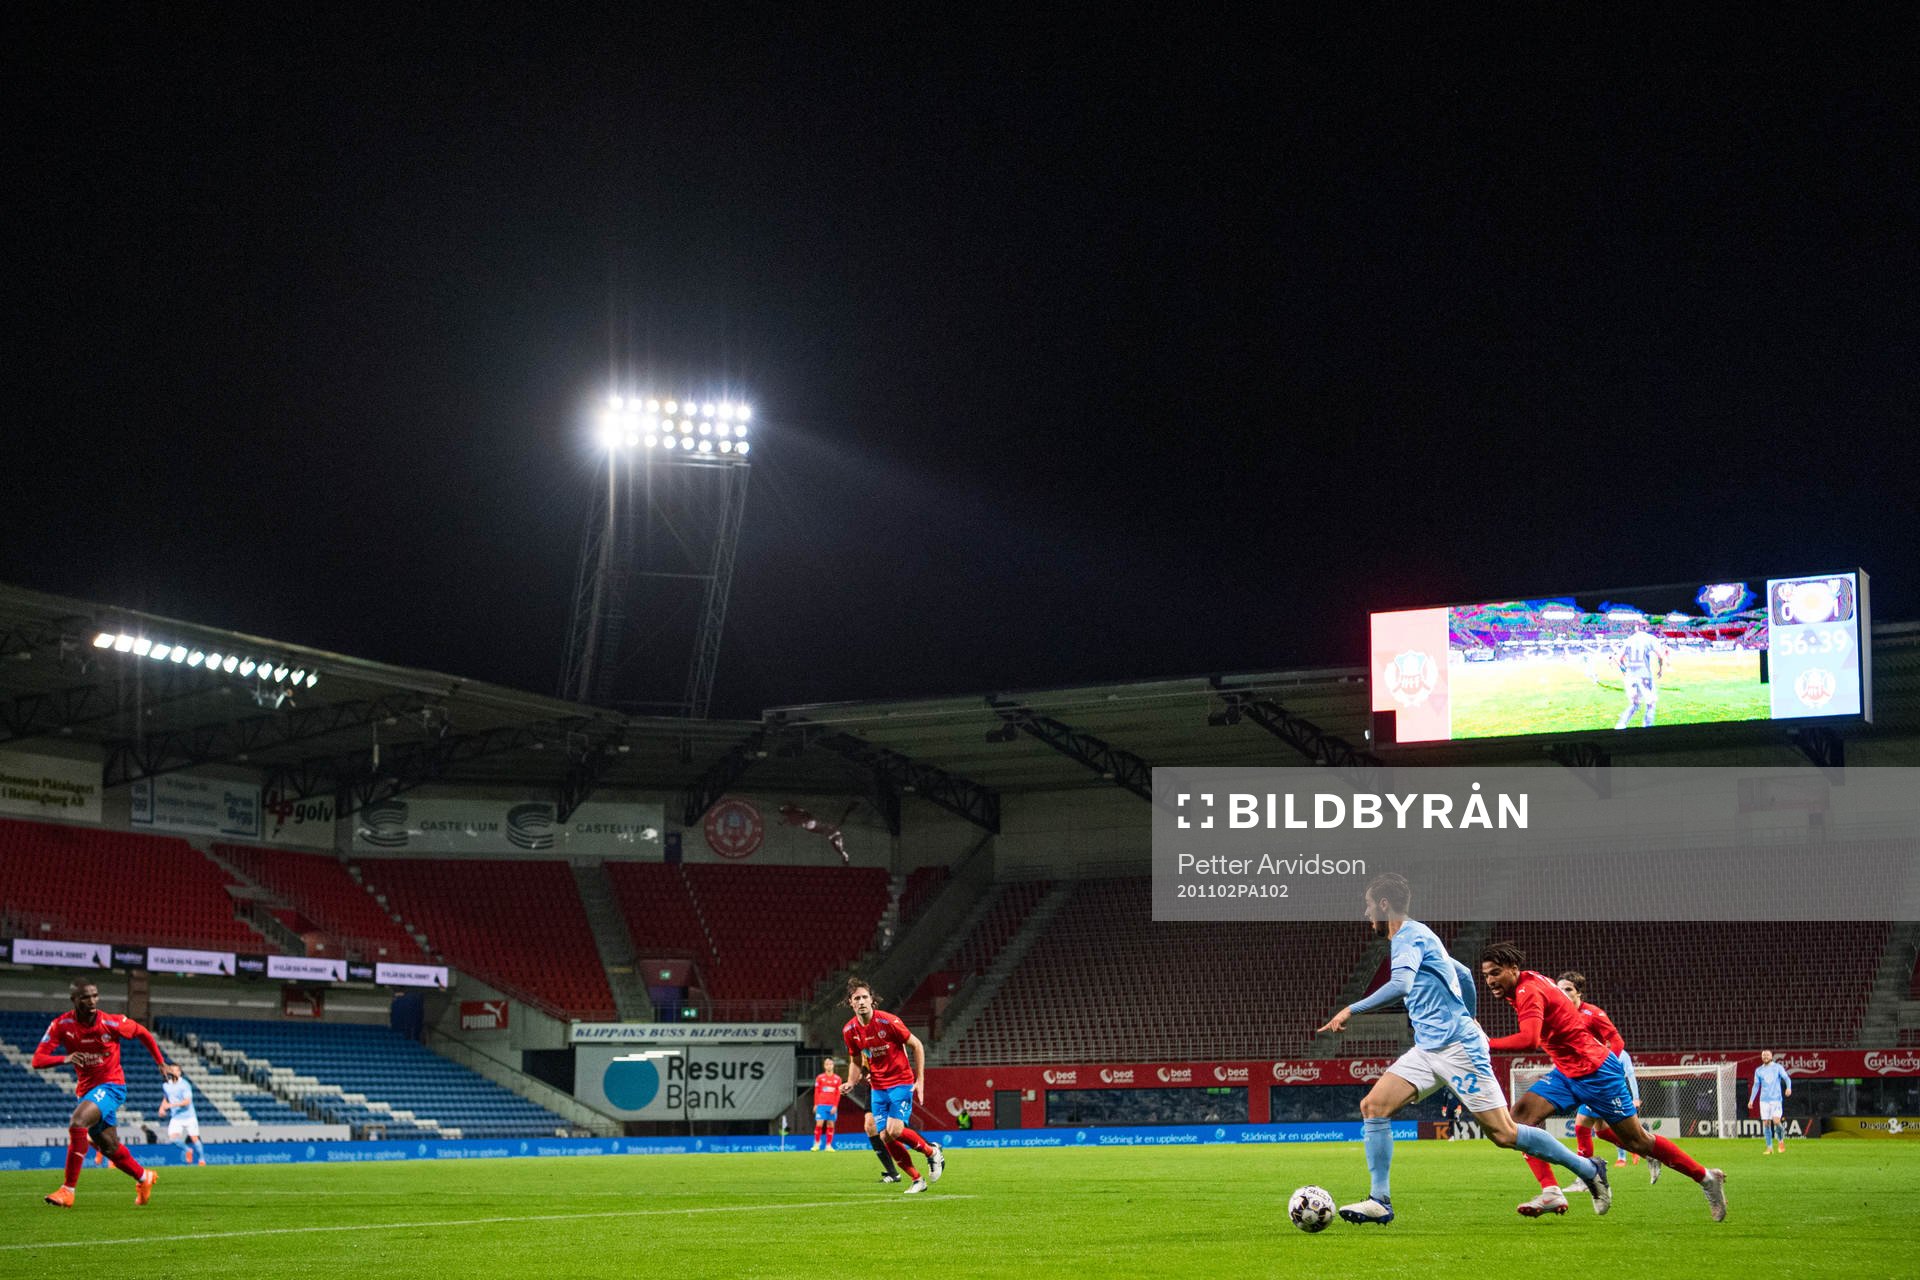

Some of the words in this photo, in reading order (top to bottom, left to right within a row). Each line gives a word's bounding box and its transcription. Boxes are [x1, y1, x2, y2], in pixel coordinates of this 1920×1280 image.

[294, 801, 334, 824] golv
[420, 820, 498, 832] CASTELLUM
[575, 1028, 646, 1038] KLIPPANS
[649, 1028, 686, 1038] BUSS
[689, 1028, 758, 1038] KLIPPANS
[761, 1028, 798, 1038] BUSS
[1864, 1052, 1920, 1071] Carlsberg
[667, 1056, 765, 1081] Resurs
[1113, 1070, 1134, 1078] beat
[1170, 1067, 1192, 1078] beat
[1227, 1067, 1248, 1077] beat
[1273, 1061, 1321, 1080] Carlsberg
[1056, 1071, 1077, 1080] beat
[1451, 1073, 1481, 1095] 22
[666, 1084, 736, 1110] Bank
[963, 1099, 991, 1110] beat
[1099, 1134, 1134, 1146] Städning
[1156, 1133, 1198, 1145] upplevelse
[1241, 1131, 1277, 1142] Städning
[1300, 1131, 1344, 1141] upplevelse
